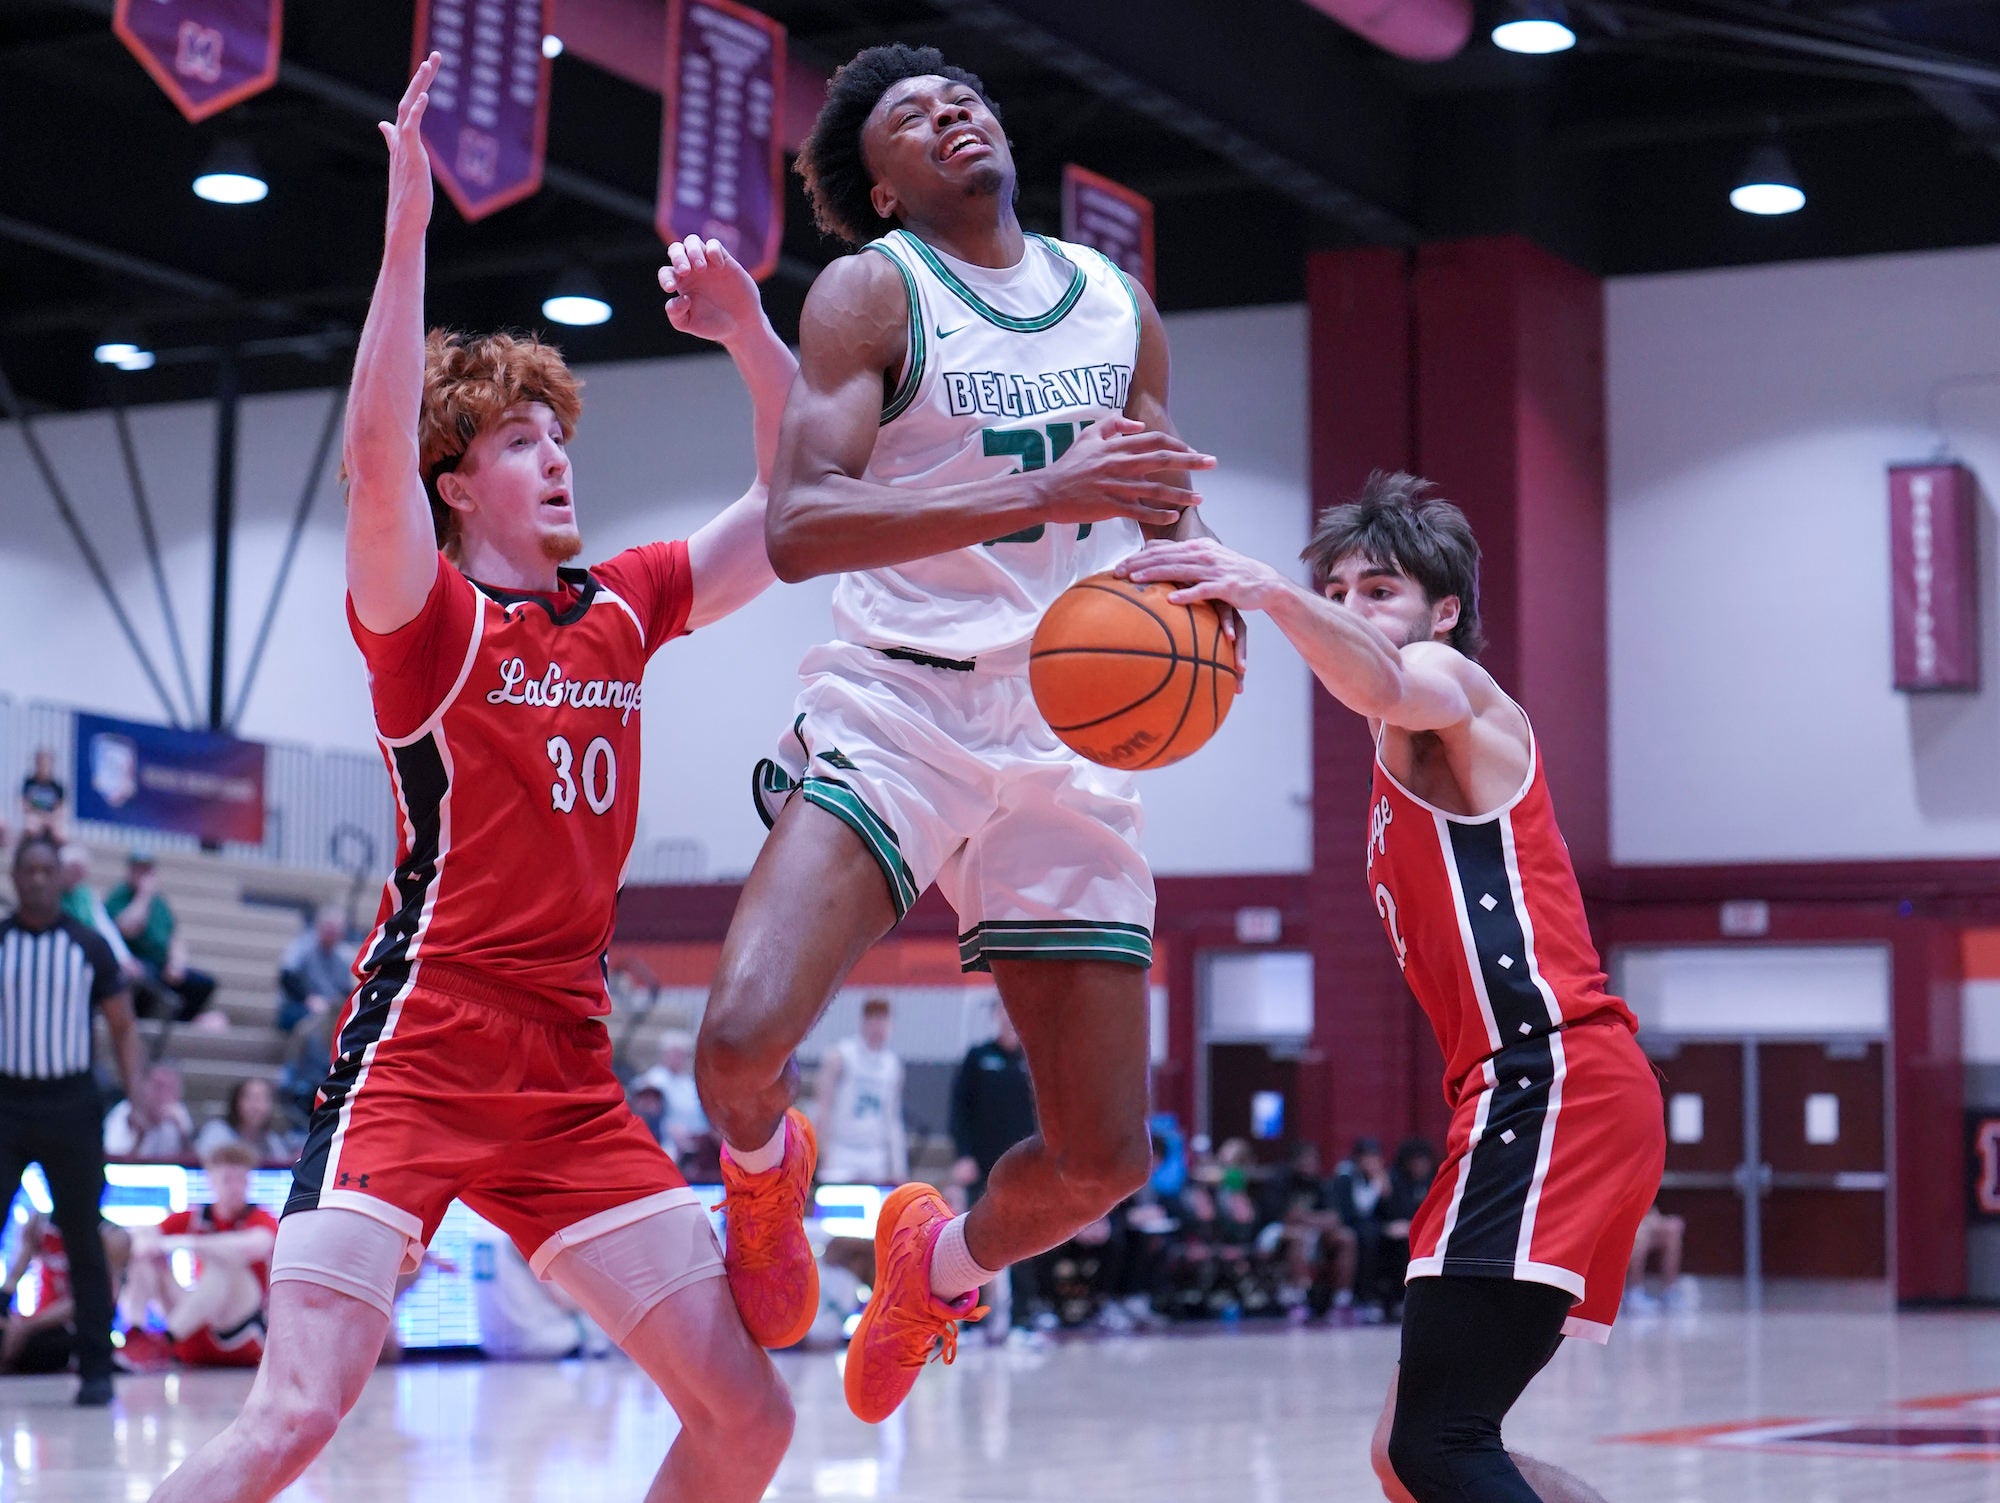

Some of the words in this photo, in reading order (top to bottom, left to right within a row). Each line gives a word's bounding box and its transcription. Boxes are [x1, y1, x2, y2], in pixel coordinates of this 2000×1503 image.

[982, 420, 1096, 546] 3
[486, 657, 642, 728] LaGrange
[546, 735, 617, 816] 30
